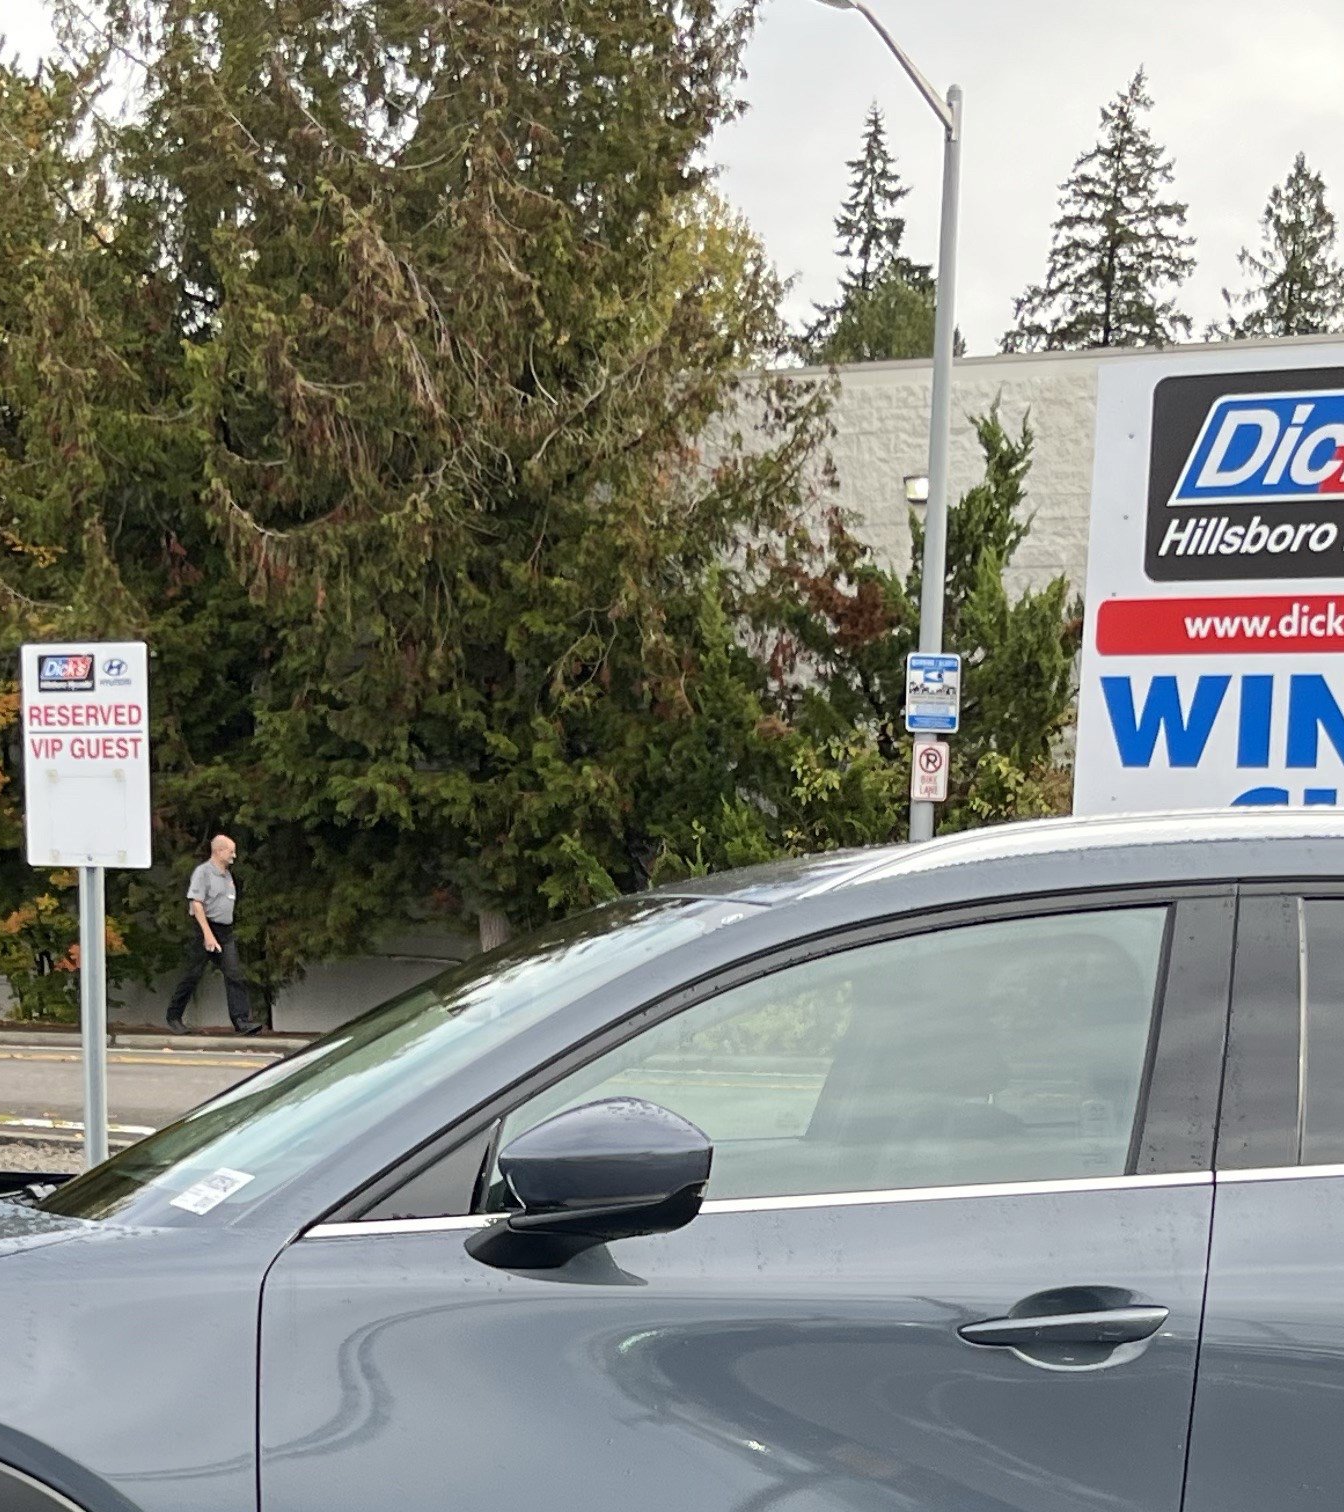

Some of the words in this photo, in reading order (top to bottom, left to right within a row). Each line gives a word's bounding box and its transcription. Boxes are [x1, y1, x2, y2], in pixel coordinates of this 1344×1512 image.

[1158, 516, 1338, 557] Hillsboro
[29, 704, 142, 726] RESERVED
[30, 738, 63, 759] VIP
[70, 737, 142, 760] GUEST
